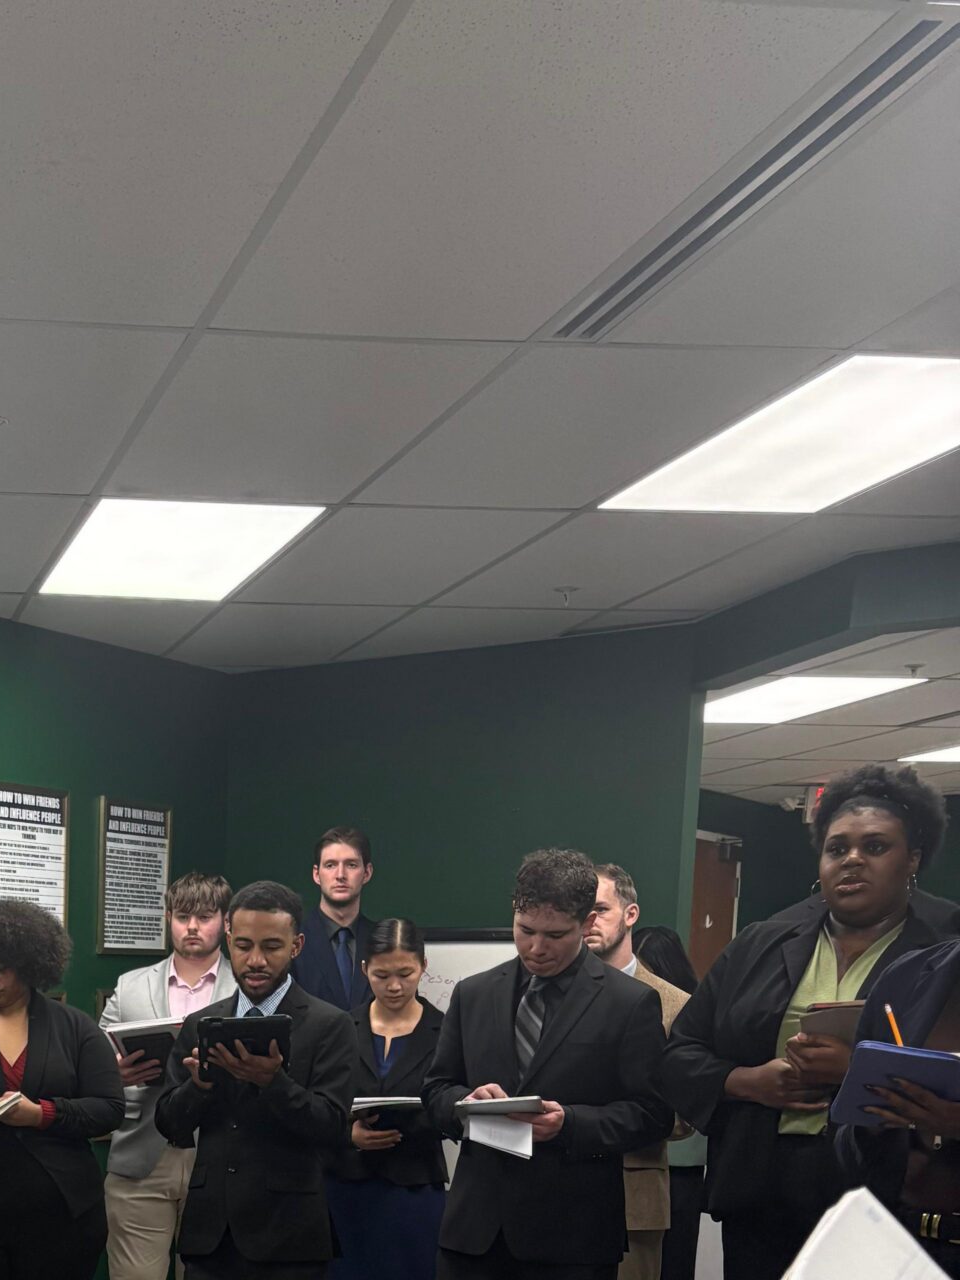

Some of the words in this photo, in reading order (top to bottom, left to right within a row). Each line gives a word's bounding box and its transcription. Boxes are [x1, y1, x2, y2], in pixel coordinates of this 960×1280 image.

[14, 792, 22, 804] TO
[22, 793, 36, 806] WIN
[36, 795, 60, 809] FRIENDS
[10, 807, 40, 822] INFLUENCE
[41, 811, 62, 824] PEOPLE
[110, 805, 124, 817] HOW
[124, 807, 131, 818] TO
[143, 810, 164, 822] FRIENDS
[108, 819, 119, 830] AND
[120, 821, 147, 834] INFLUENCE
[148, 824, 165, 836] PEOPLE
